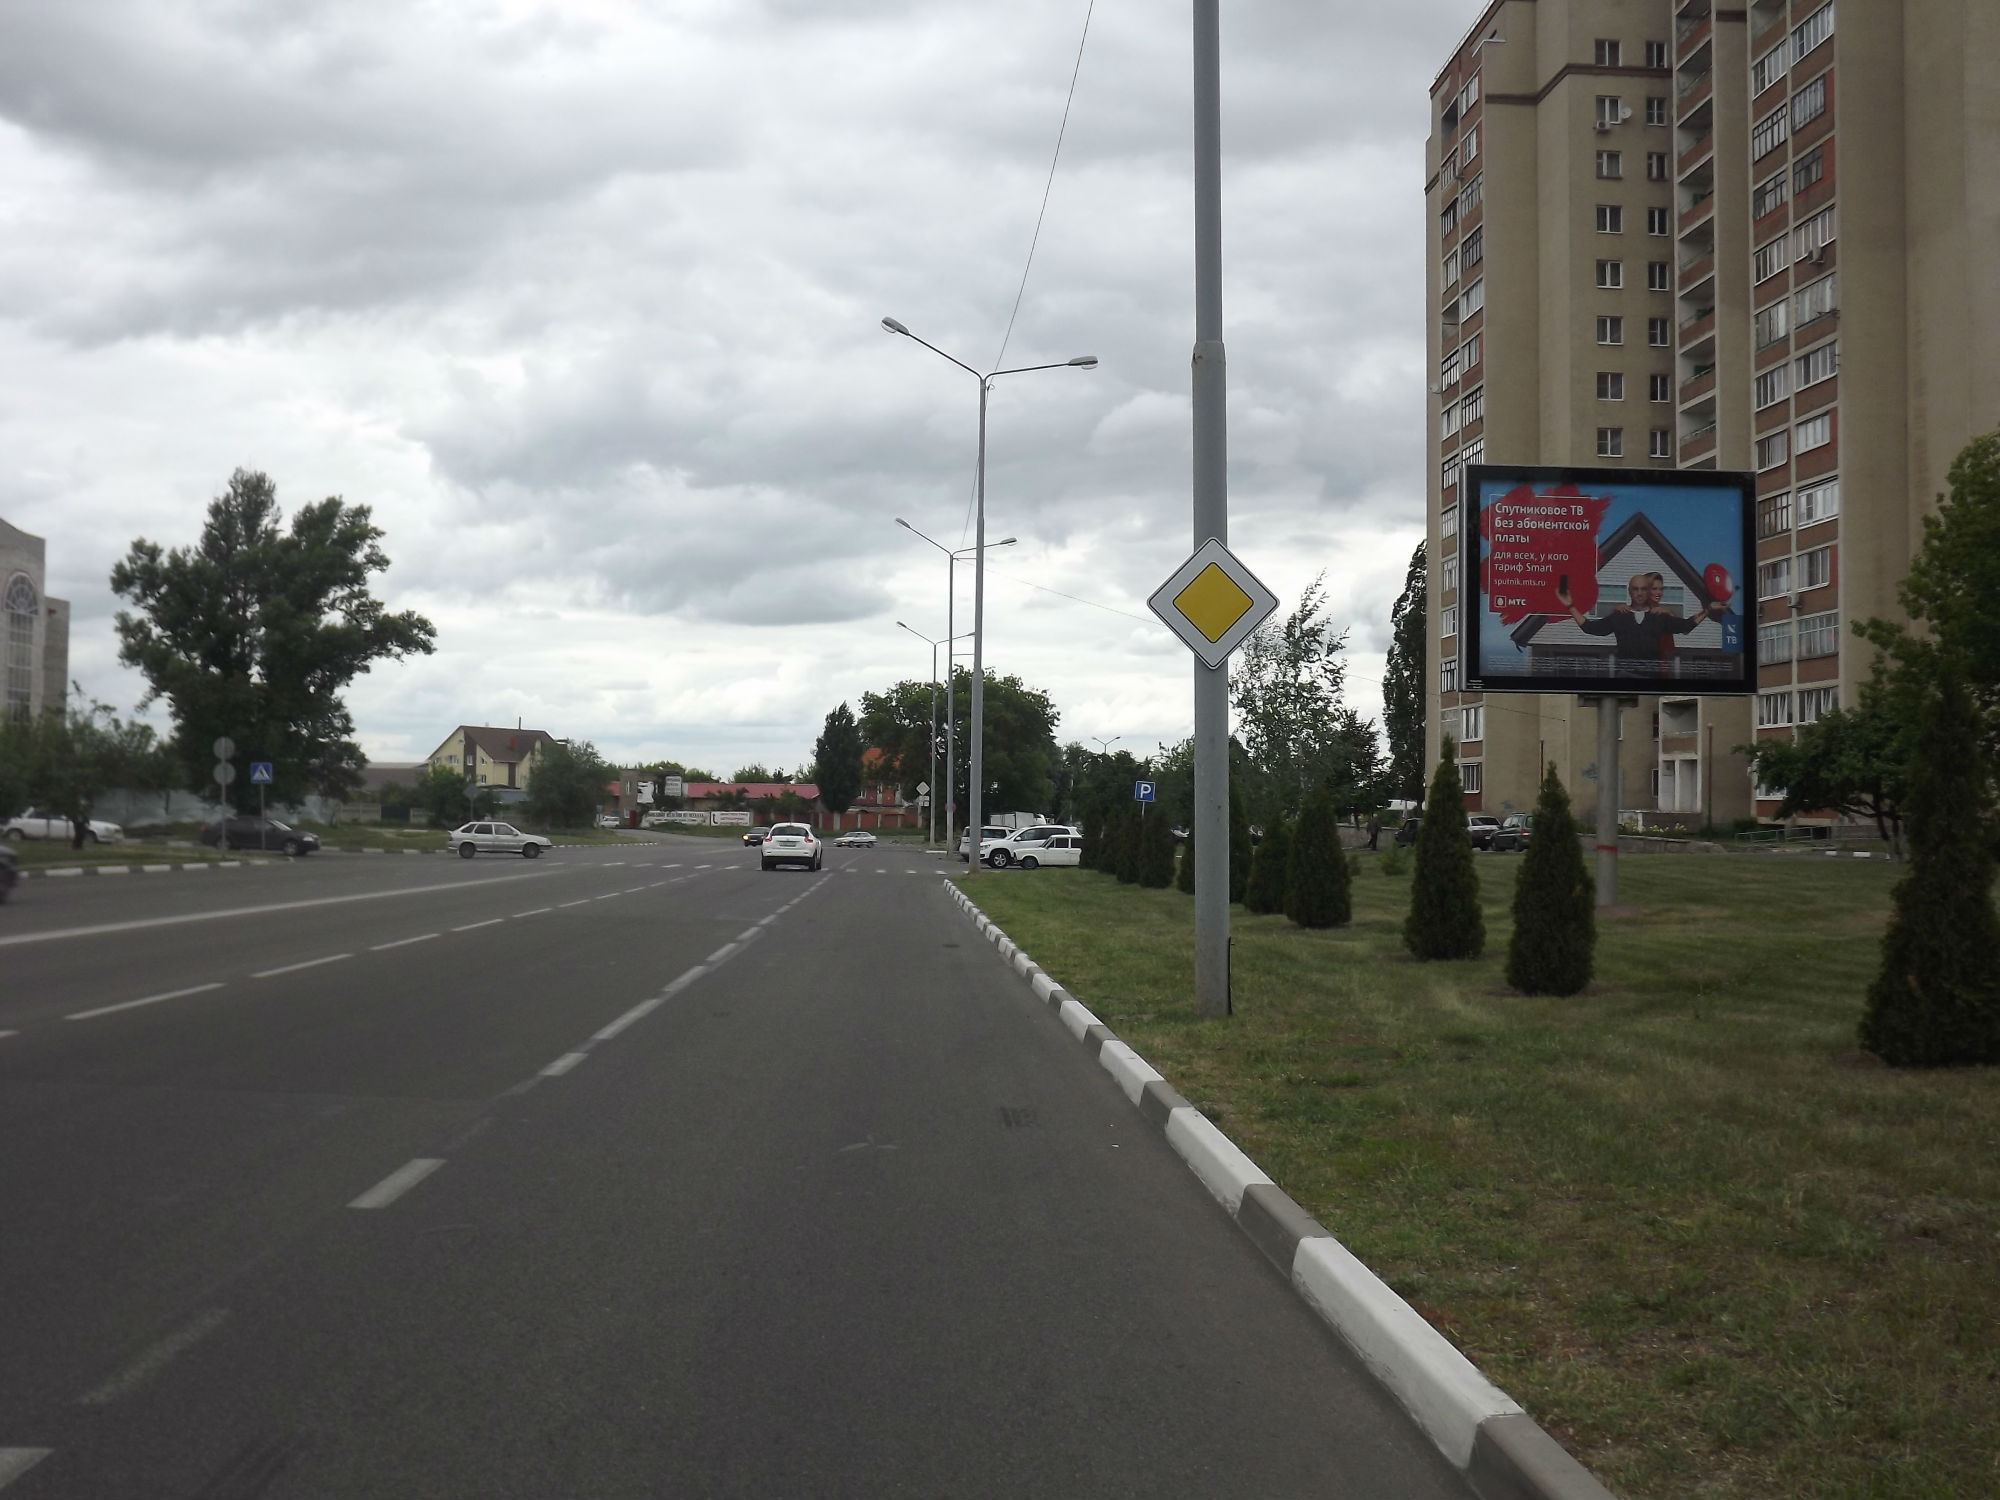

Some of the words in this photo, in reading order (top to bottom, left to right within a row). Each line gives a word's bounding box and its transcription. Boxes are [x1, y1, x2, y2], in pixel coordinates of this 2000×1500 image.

[1495, 502, 1568, 516] Спутниковое
[1570, 505, 1584, 515] ТВ
[1494, 517, 1514, 528] без
[1516, 518, 1590, 531] абонентской
[1495, 534, 1529, 543] платы
[1494, 551, 1511, 560] для
[1514, 552, 1538, 561] всех,
[1540, 553, 1545, 562] у
[1547, 553, 1569, 561] кого
[1494, 562, 1523, 573] тариф
[1526, 562, 1553, 572] Smart
[1494, 577, 1546, 587] sputnik.mts.ru
[1726, 635, 1737, 645] ТВ
[1140, 783, 1151, 799] P
